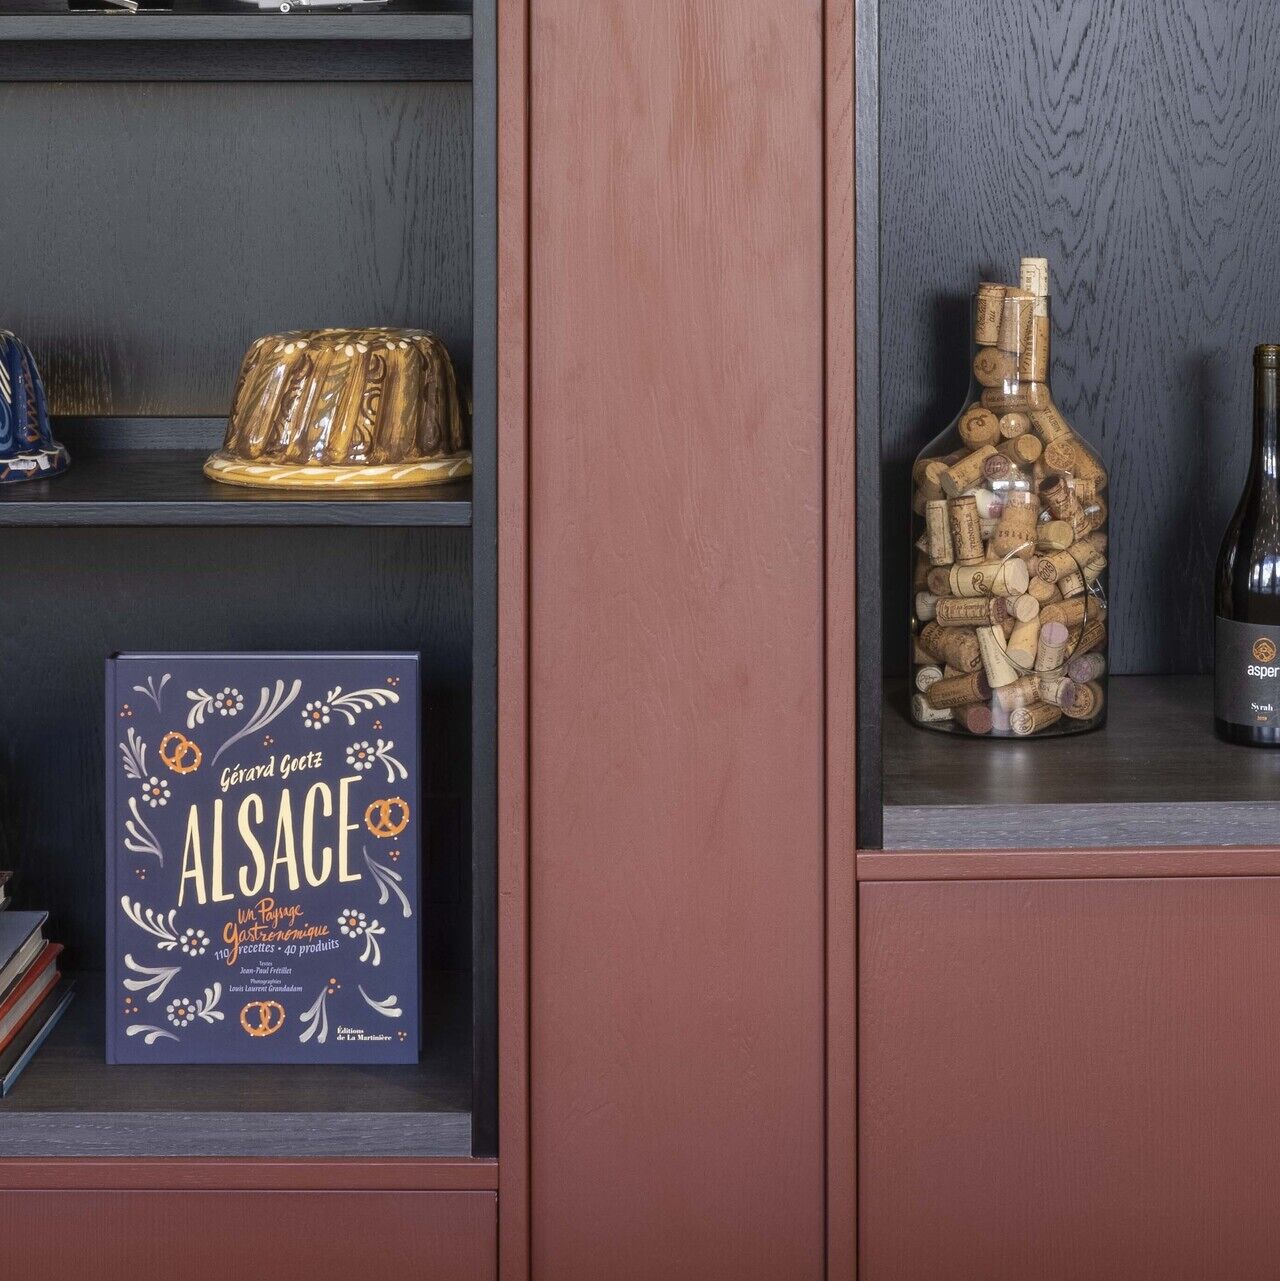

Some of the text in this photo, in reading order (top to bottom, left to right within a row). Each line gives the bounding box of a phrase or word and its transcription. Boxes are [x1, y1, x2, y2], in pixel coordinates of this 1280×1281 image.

[1040, 561, 1056, 582] 2015
[1247, 664, 1280, 680] asper
[1251, 702, 1274, 712] Syrah
[220, 751, 323, 792] Gérard Goetz
[178, 775, 362, 907] ALSACE
[255, 898, 304, 929] Paysage
[214, 939, 340, 961] 110 recettes 40 produits
[240, 966, 292, 975] Jean-Paul Frétillet
[229, 984, 303, 993] Louis Laurent Grandadam
[336, 1026, 364, 1035] Éditions
